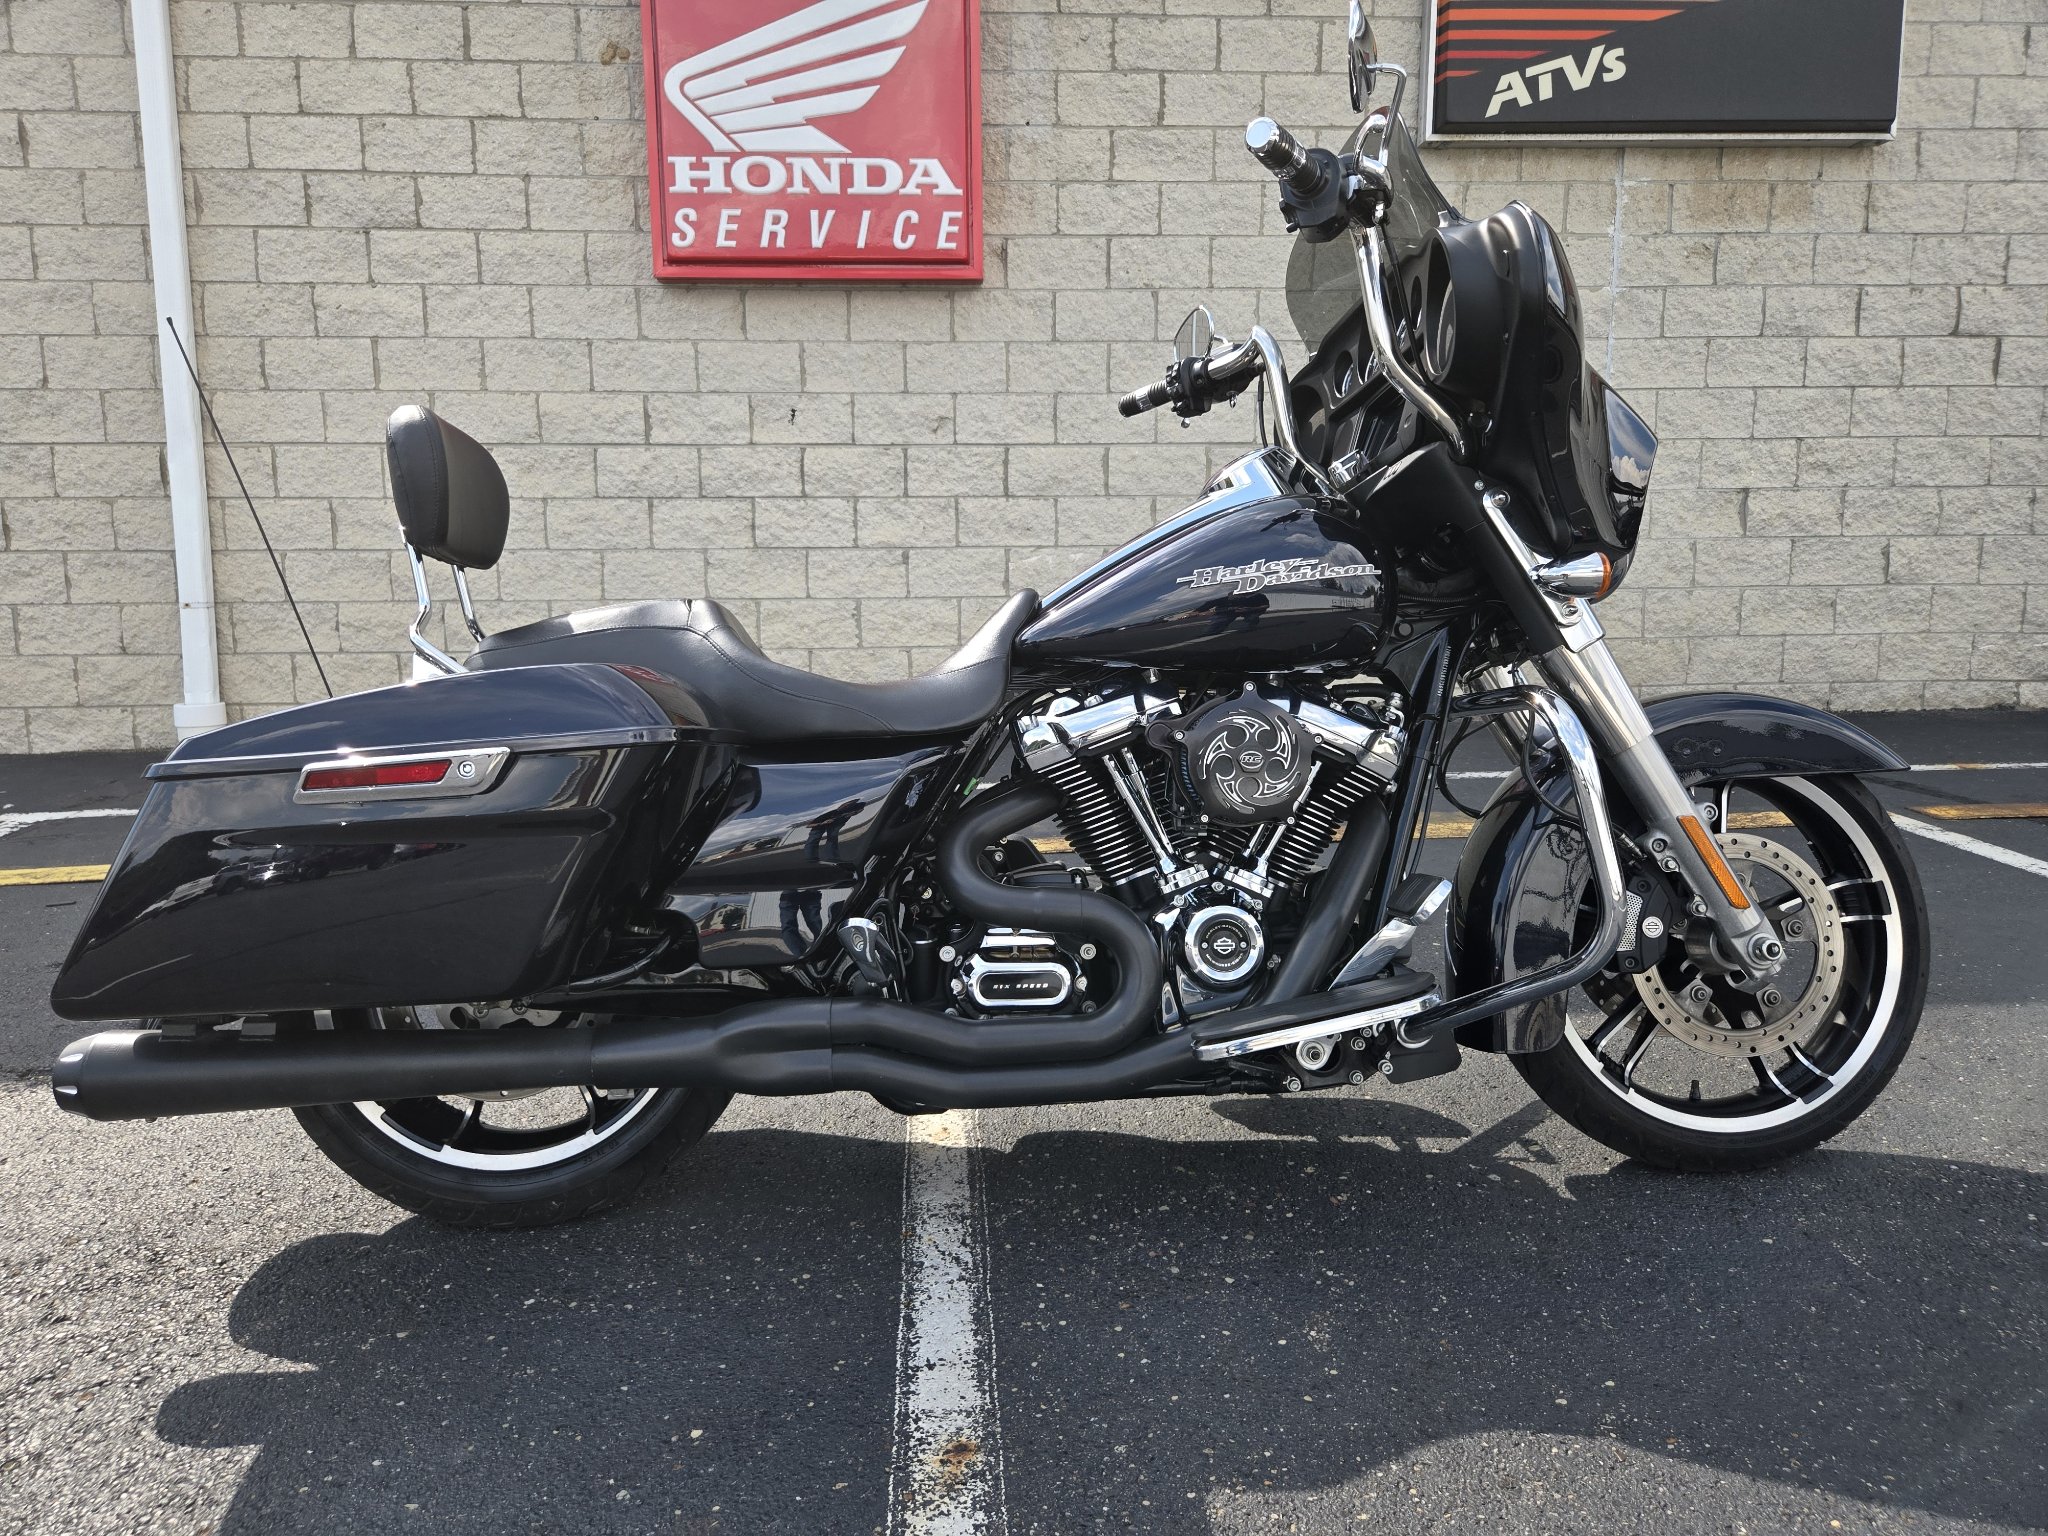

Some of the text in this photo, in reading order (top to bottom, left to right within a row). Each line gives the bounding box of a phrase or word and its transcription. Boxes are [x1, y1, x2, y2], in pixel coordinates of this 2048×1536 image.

[1484, 44, 1627, 118] ATVs
[667, 155, 963, 196] HONDA
[671, 207, 963, 250] SERVICE
[1232, 563, 1382, 595] Davidson
